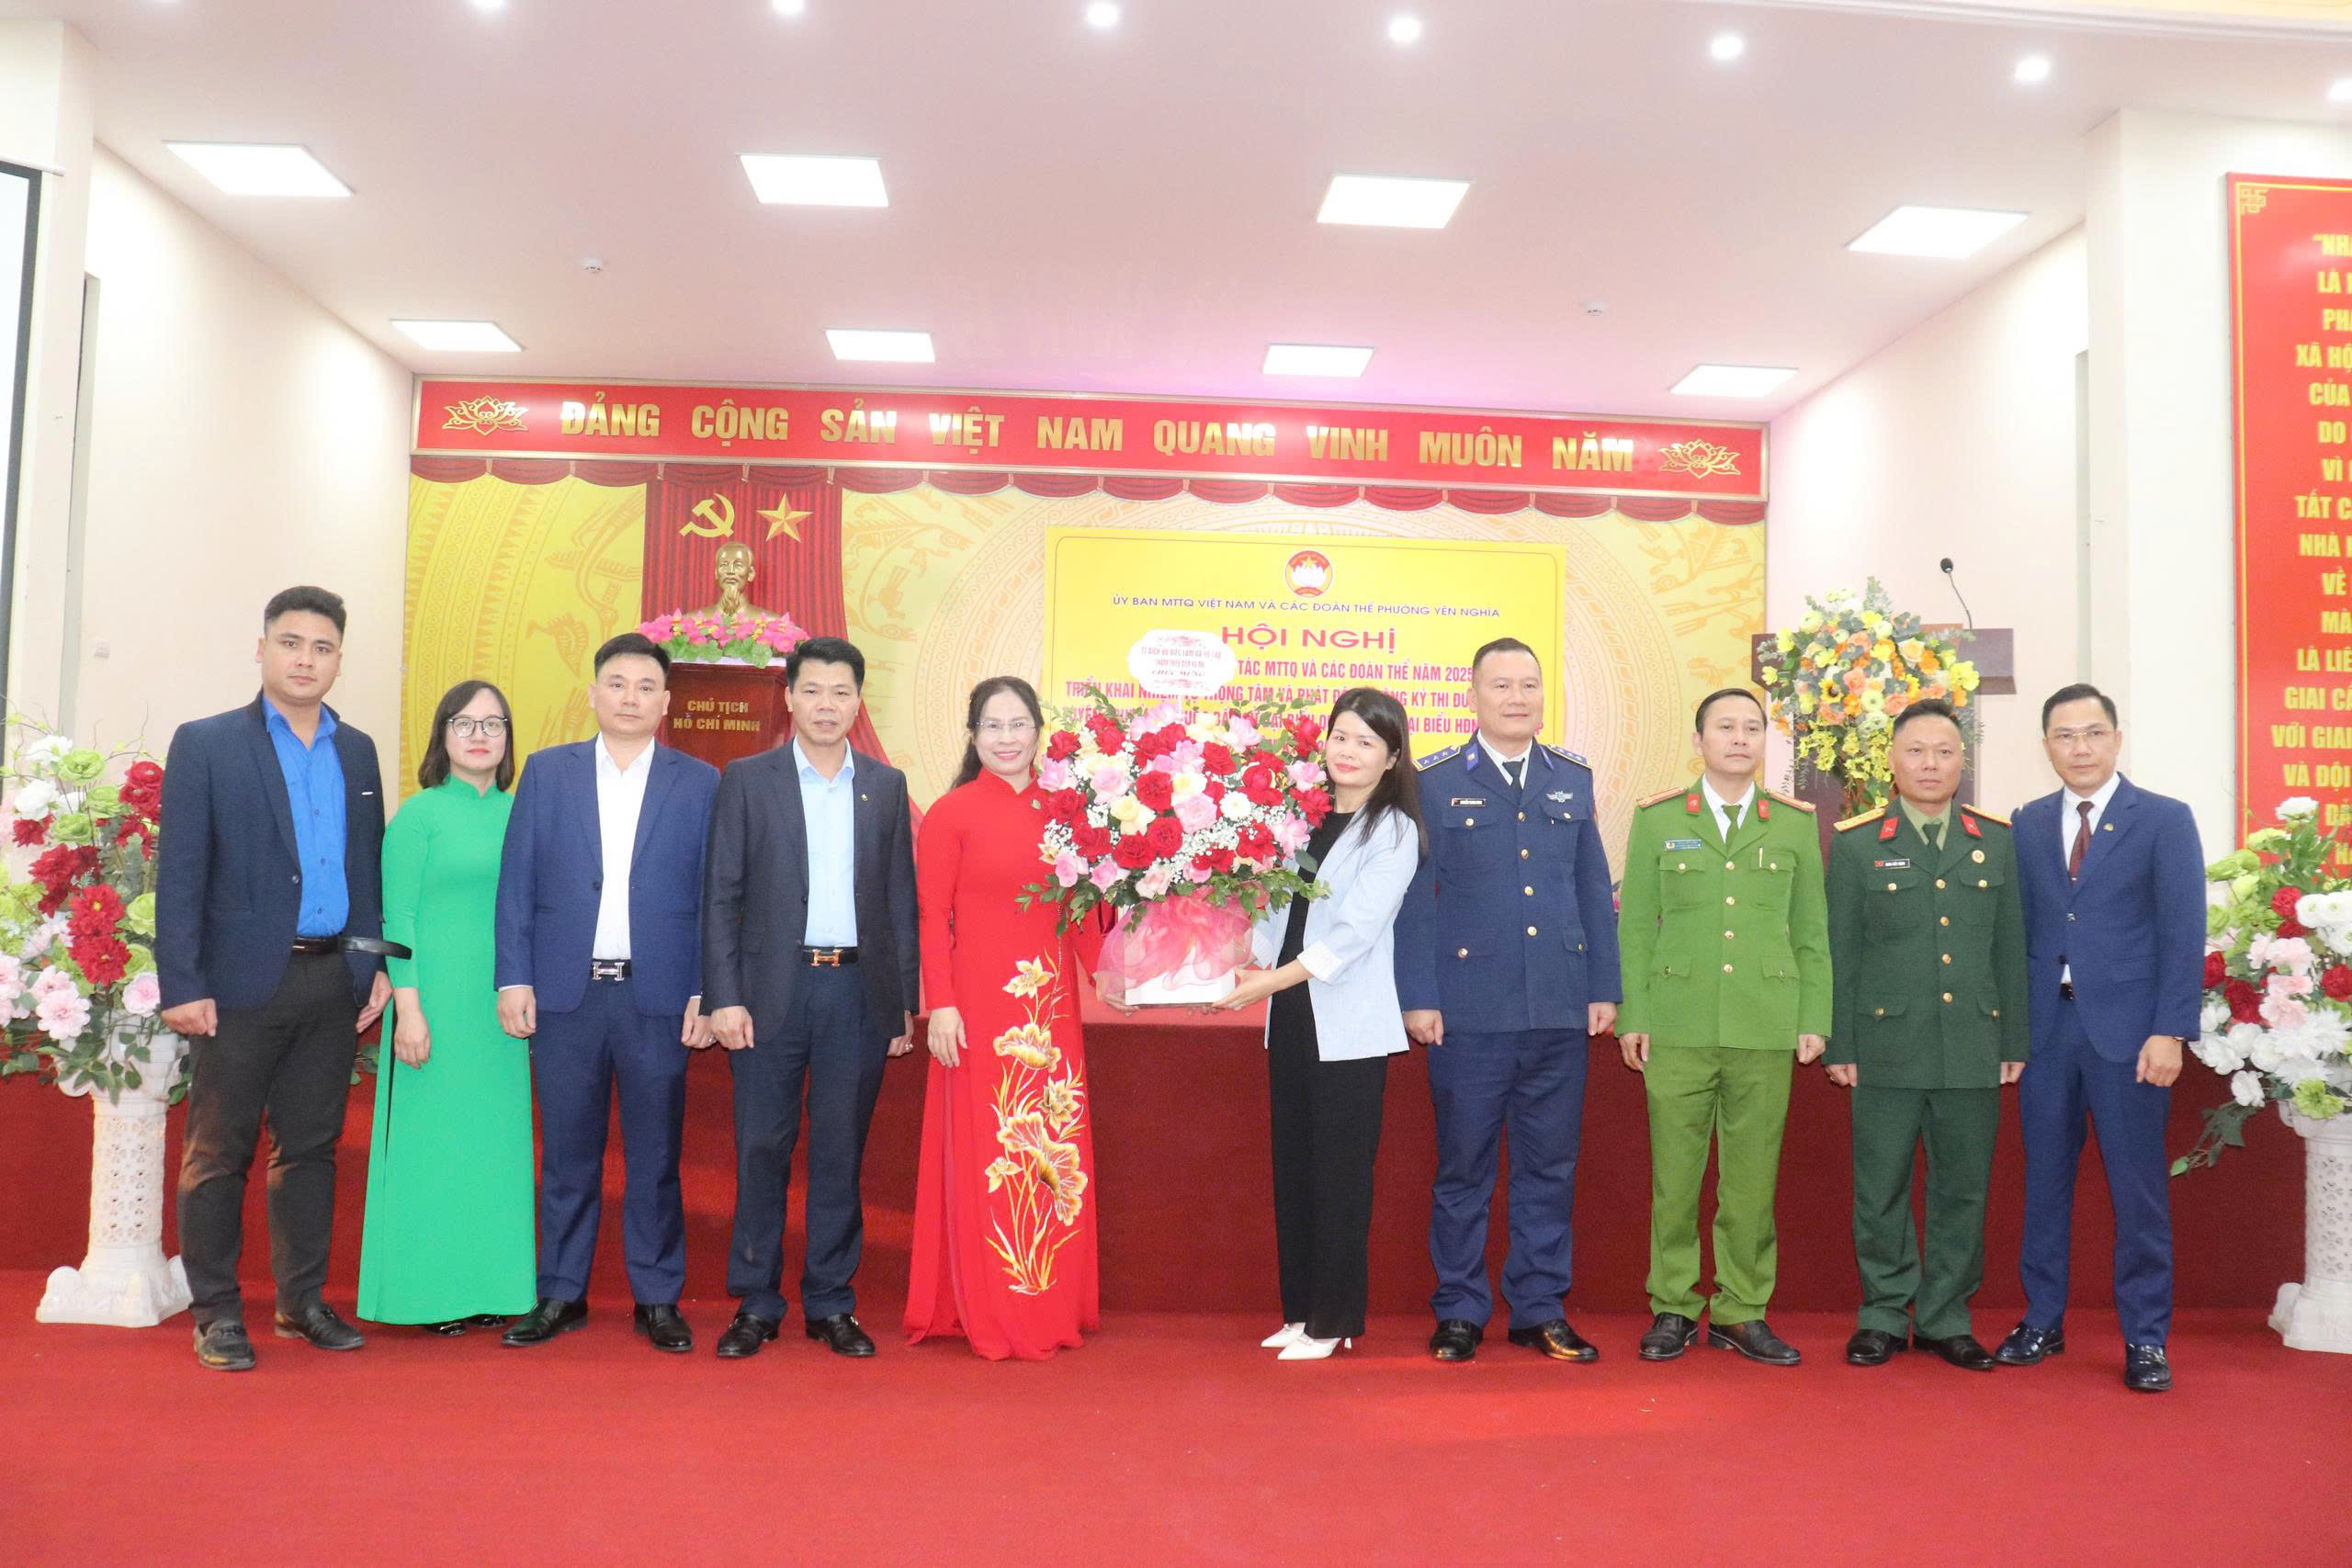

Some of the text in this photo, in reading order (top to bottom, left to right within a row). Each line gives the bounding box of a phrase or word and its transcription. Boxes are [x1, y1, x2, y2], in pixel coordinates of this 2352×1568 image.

[2317, 267, 2342, 294] LÀ
[560, 390, 1634, 472] ĐẢNG CỘNG SẢN VIỆT NAM QUANG VINH MUÔN NĂM
[2318, 421, 2346, 445] DO
[2322, 456, 2344, 482] VÌ
[2300, 531, 2342, 558] NHÀ
[1132, 597, 1158, 606] BAN
[1161, 598, 1194, 607] MTTQ
[1198, 597, 1222, 609] VIỆT
[1226, 600, 1255, 609] NAM
[1259, 599, 1276, 610] VÀ
[1280, 600, 1308, 611] CÁC
[1313, 601, 1350, 612] ĐOÀN
[1434, 604, 1456, 615] YÊN
[1222, 624, 1396, 654] HỘI NGHỊ
[1238, 660, 1261, 676] TÁC
[1264, 660, 1297, 678] MTTQ
[1302, 659, 1317, 678] VÀ
[1321, 660, 1345, 679] CÁC
[1350, 660, 1383, 681] ĐOÀN
[1413, 661, 1441, 682] NĂM
[1445, 667, 1473, 682] 2025
[2297, 645, 2322, 672] LÀ
[1105, 682, 1134, 698] KHAI
[1411, 688, 1427, 706] KÝ
[1430, 692, 1449, 707] THI
[1453, 693, 1472, 708] ĐU
[2284, 686, 2326, 710] GIAI
[687, 697, 750, 715] CHỦ TỊCH
[673, 712, 761, 732] HỒ CHÍ MINH
[1454, 717, 1478, 734] HĐN
[2271, 721, 2306, 749] VỚI
[2283, 761, 2351, 792] VÀ ĐỘI
